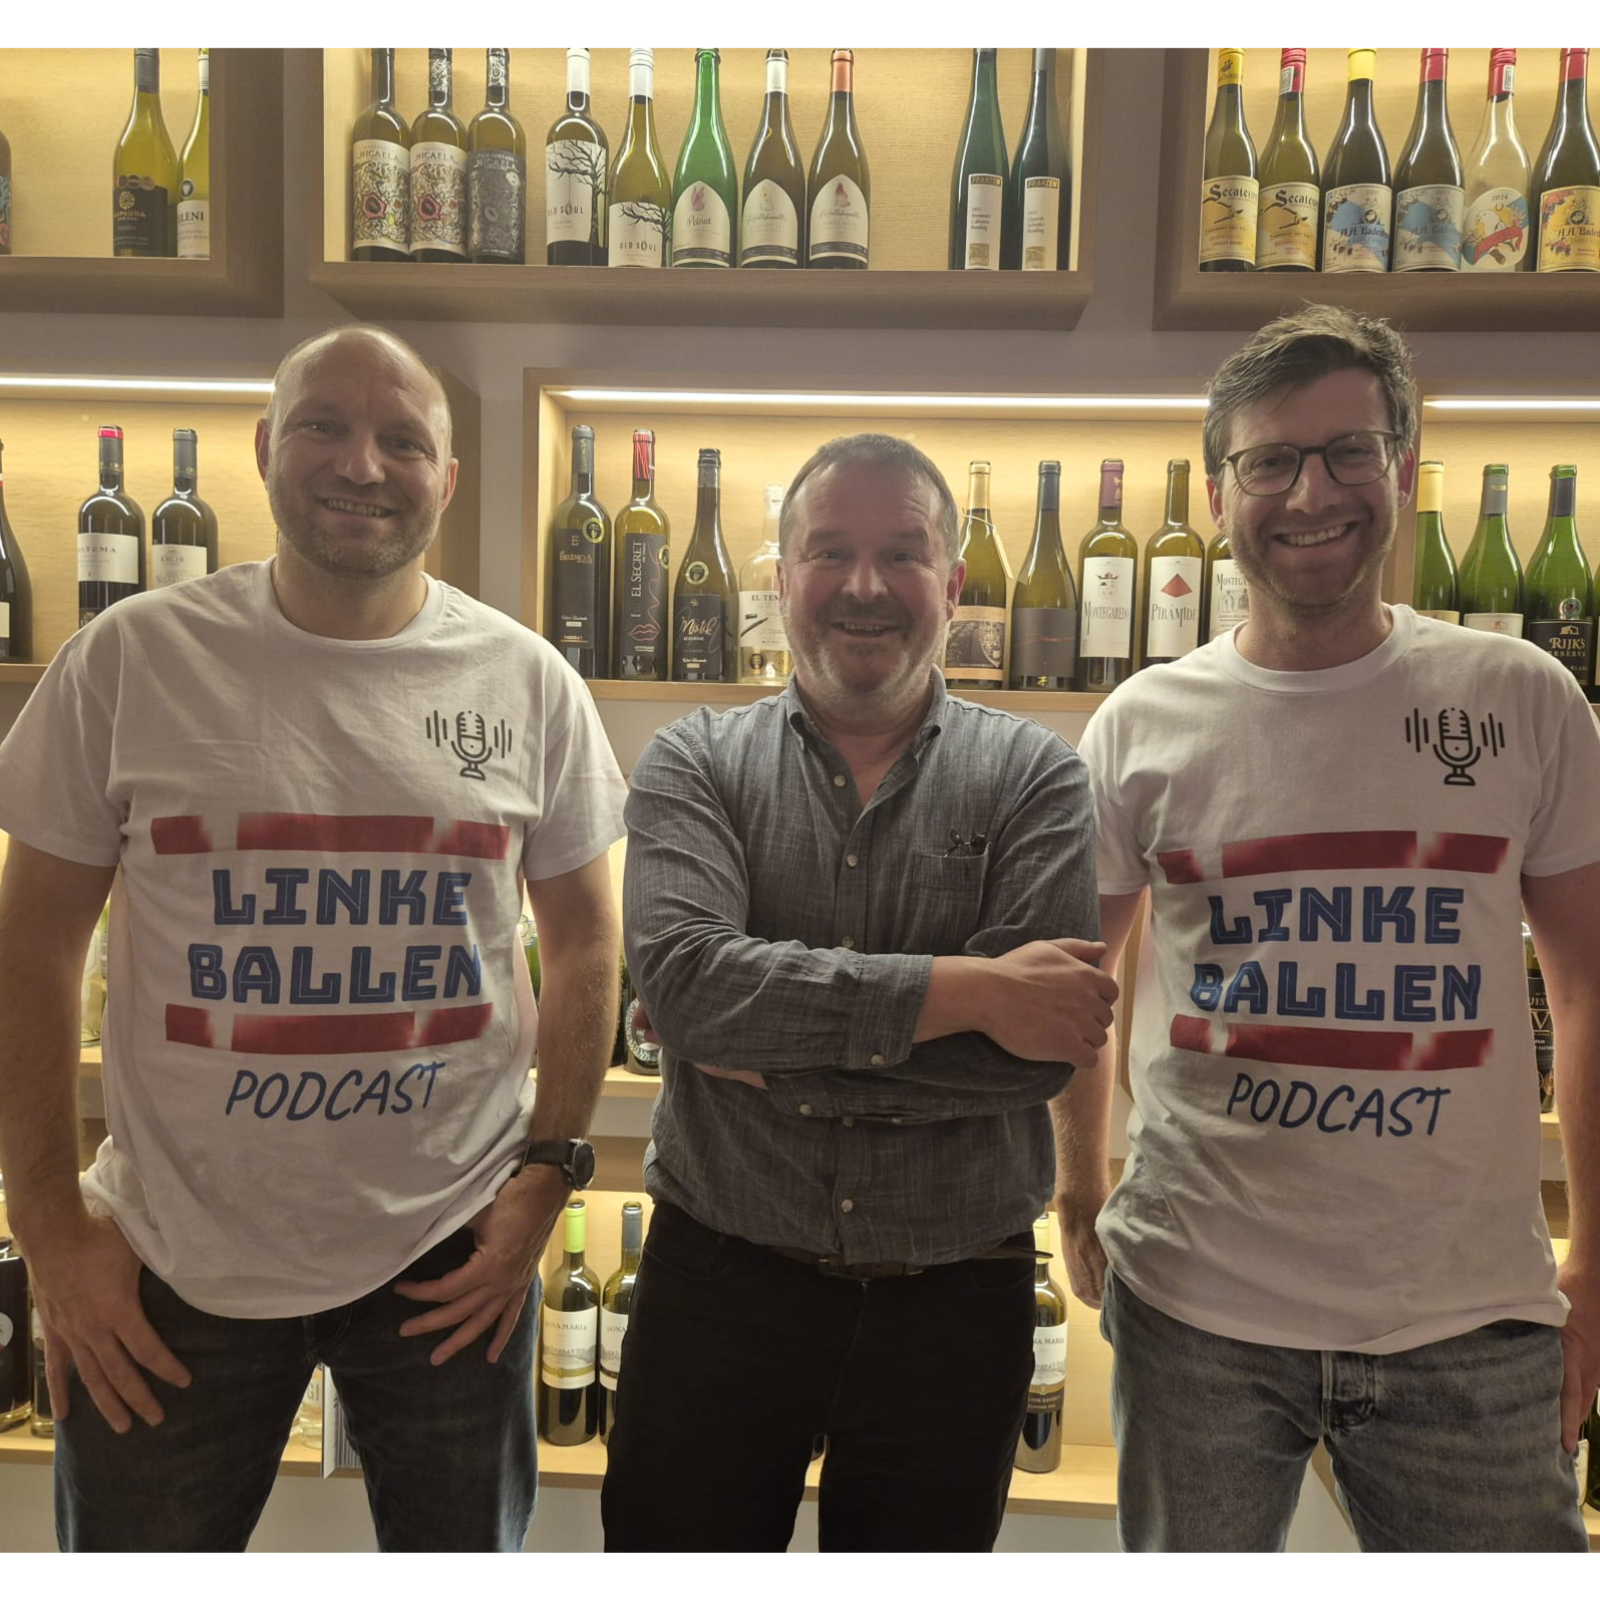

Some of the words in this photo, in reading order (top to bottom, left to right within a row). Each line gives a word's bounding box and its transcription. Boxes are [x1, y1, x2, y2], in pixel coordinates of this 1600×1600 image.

[358, 150, 402, 163] MICAELA
[414, 151, 459, 164] MICAELA
[473, 158, 519, 173] MICAELA
[211, 868, 472, 925] LINKE
[1207, 886, 1464, 945] LINKE
[187, 943, 482, 1005] BALLEN
[1190, 960, 1481, 1022] BALLEN
[225, 1061, 446, 1121] PODCAST
[1226, 1072, 1451, 1137] PODCAST
